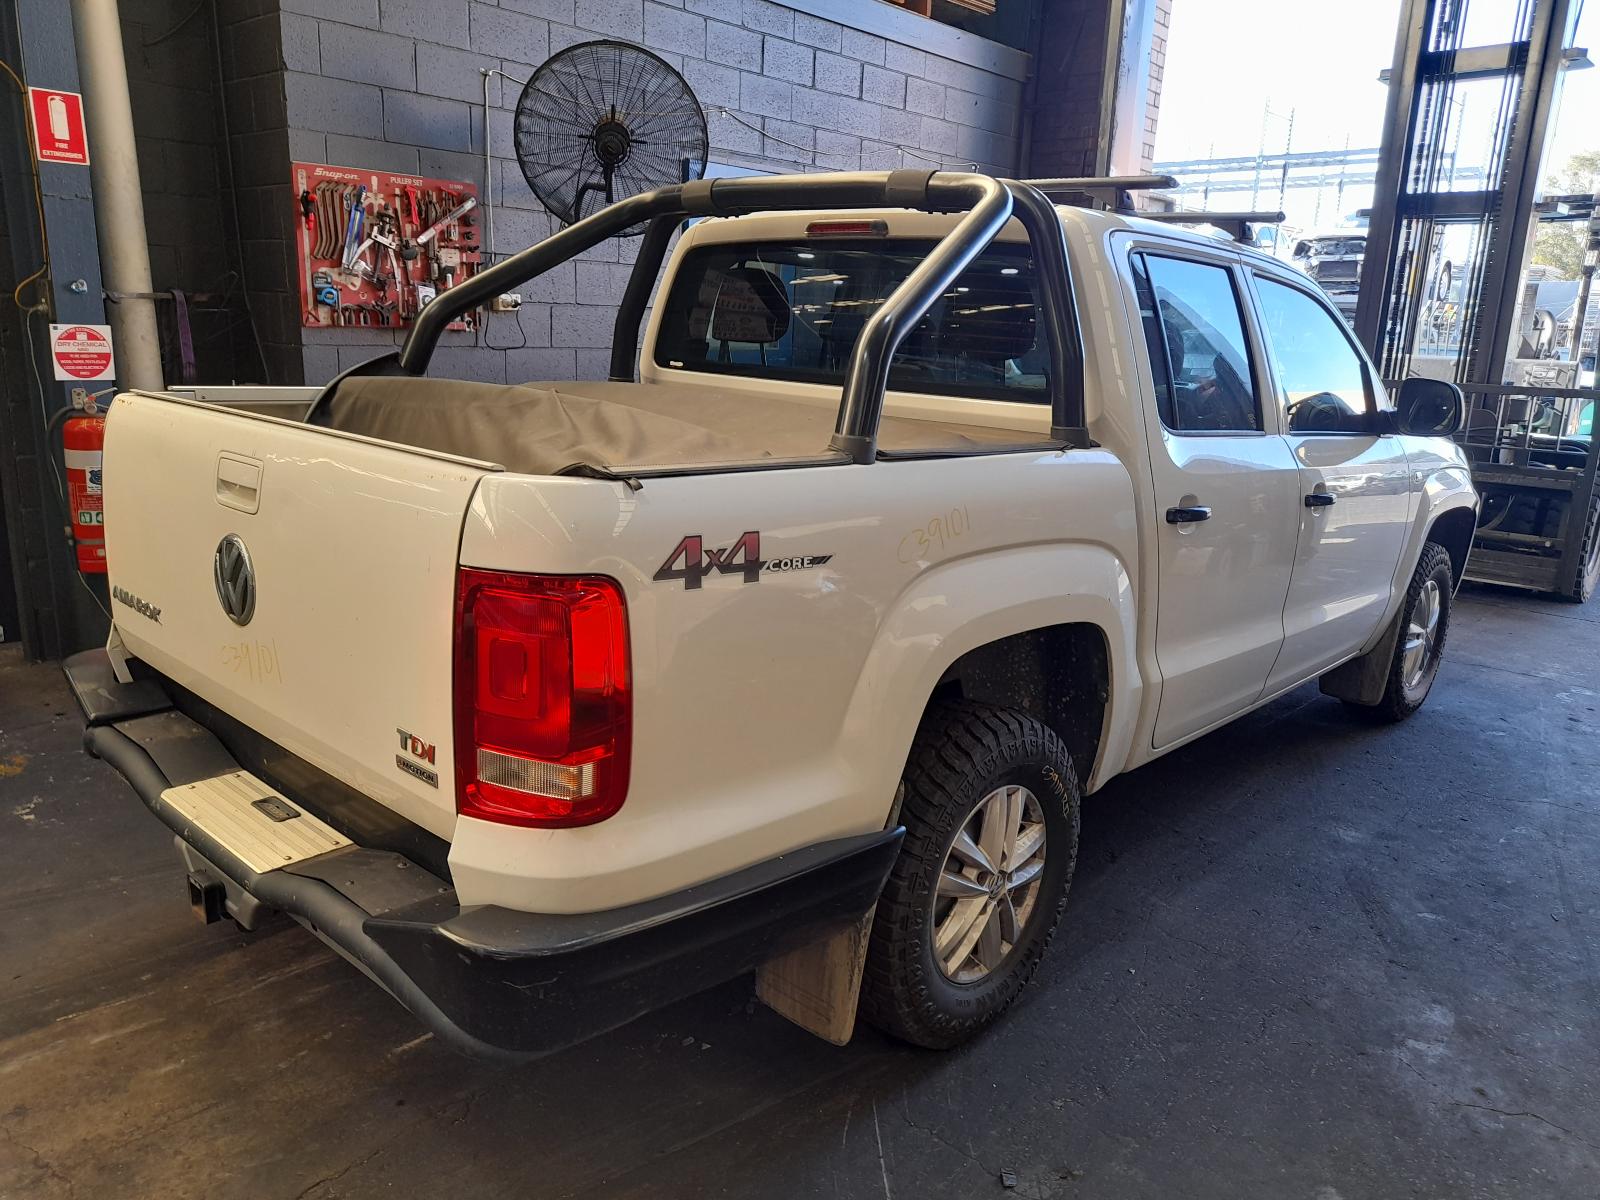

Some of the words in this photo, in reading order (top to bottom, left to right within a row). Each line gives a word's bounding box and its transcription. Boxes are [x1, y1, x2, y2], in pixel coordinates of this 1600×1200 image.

[313, 167, 360, 180] Snap-on
[413, 179, 423, 187] SET
[652, 530, 761, 590] 4x4
[769, 556, 814, 571] CORE
[396, 727, 436, 765] TDI
